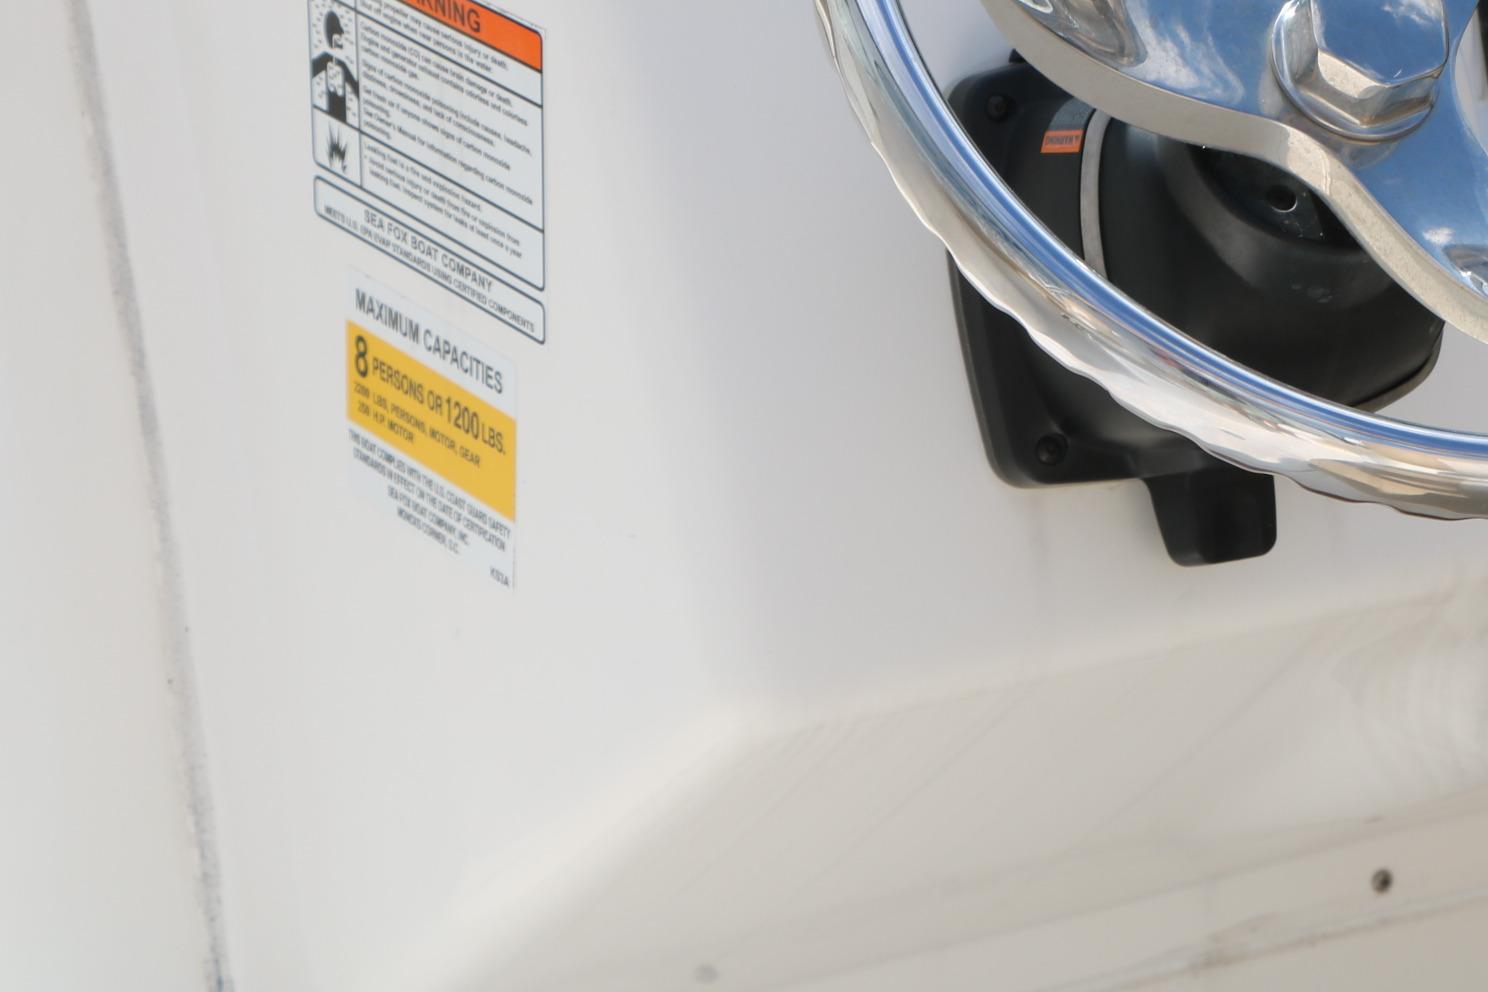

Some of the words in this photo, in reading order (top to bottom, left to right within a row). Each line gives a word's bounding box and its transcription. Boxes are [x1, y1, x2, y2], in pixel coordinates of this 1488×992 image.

[363, 206, 383, 231] SEA
[386, 220, 406, 245] FOX
[410, 233, 438, 263] BOAT
[440, 251, 493, 295] COMPANY
[354, 287, 419, 346] MAXIMUM
[422, 326, 502, 395] CAPACITIES
[354, 332, 368, 380] 8
[372, 355, 424, 406] PERSONS
[426, 387, 442, 416] OR
[445, 395, 479, 441] 1200
[481, 421, 506, 456] LBS.
